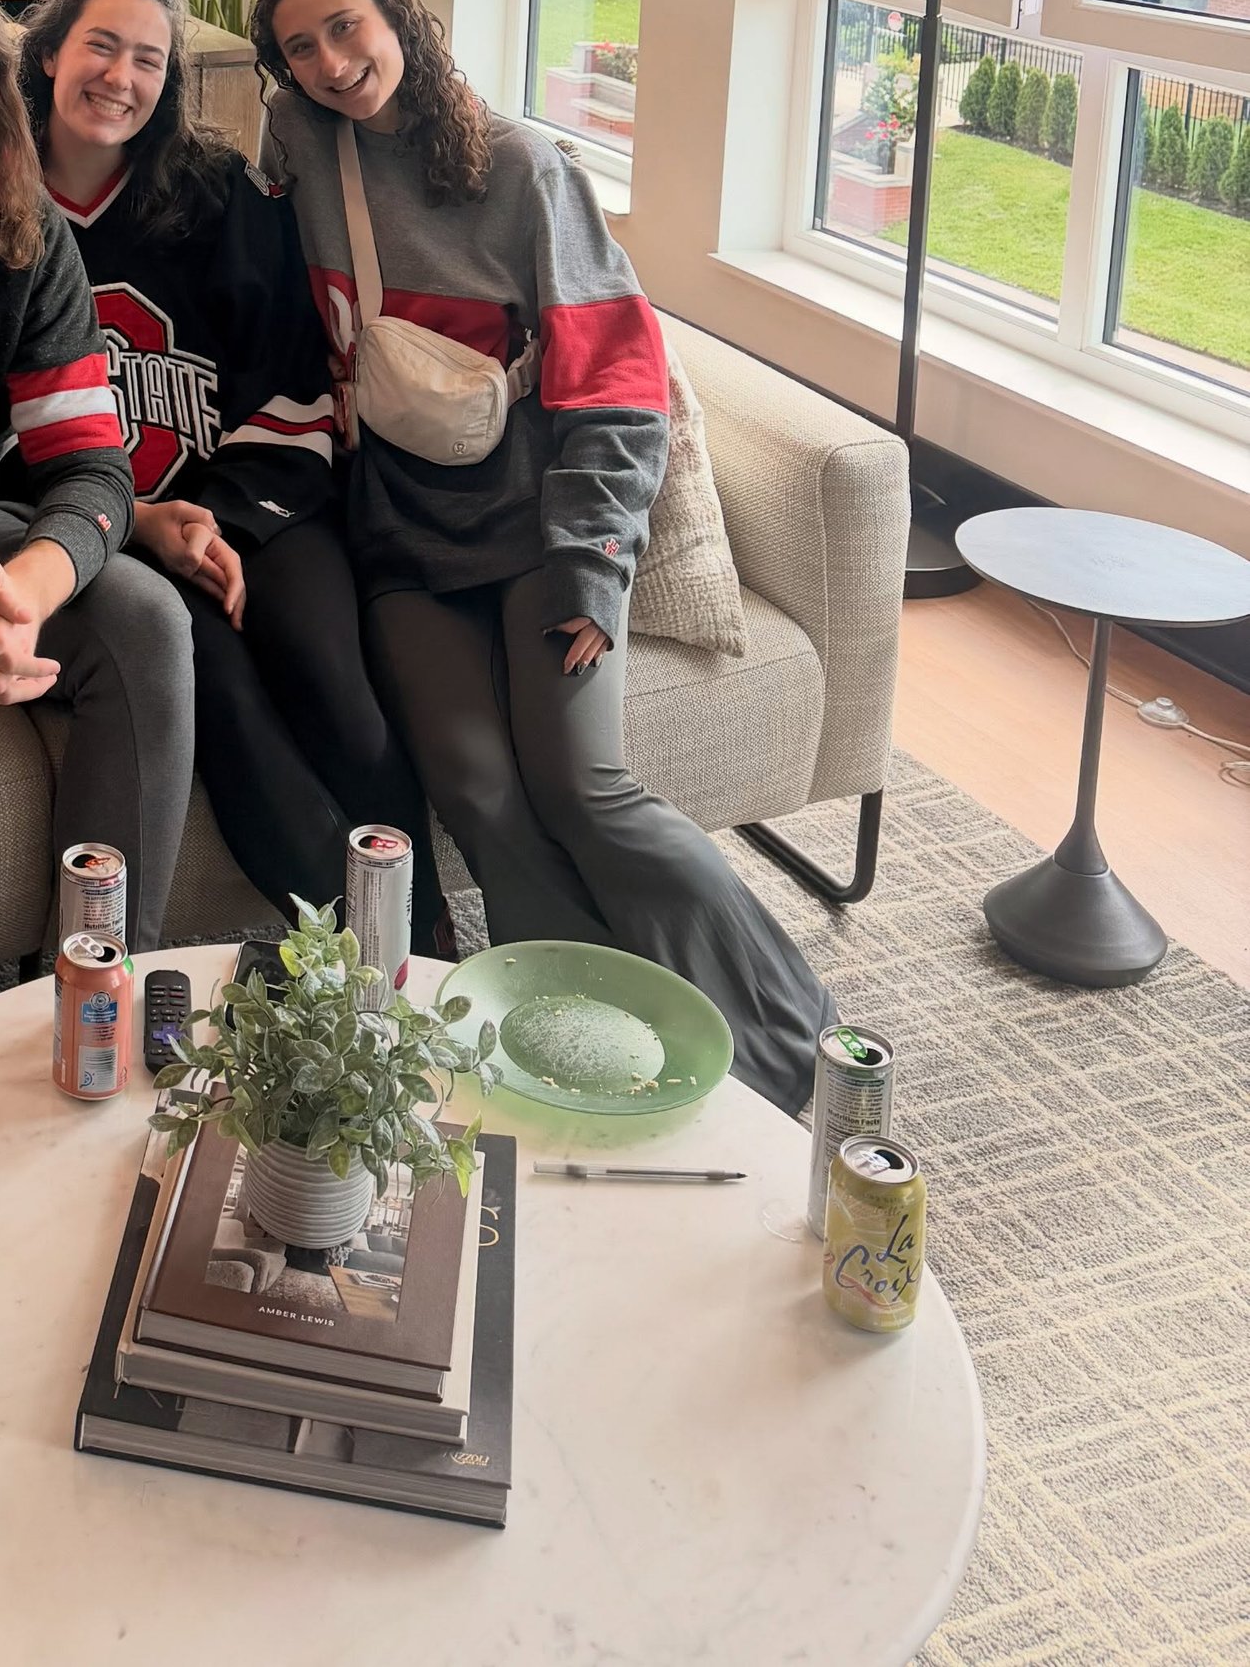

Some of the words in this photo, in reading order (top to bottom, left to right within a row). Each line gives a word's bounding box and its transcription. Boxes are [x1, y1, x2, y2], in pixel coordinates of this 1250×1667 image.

[828, 1108, 860, 1125] Nutrition
[861, 1117, 880, 1126] Facts
[876, 1213, 916, 1264] La
[835, 1244, 920, 1303] Croix
[258, 1306, 298, 1320] AMBER
[300, 1314, 336, 1327] LEWIS
